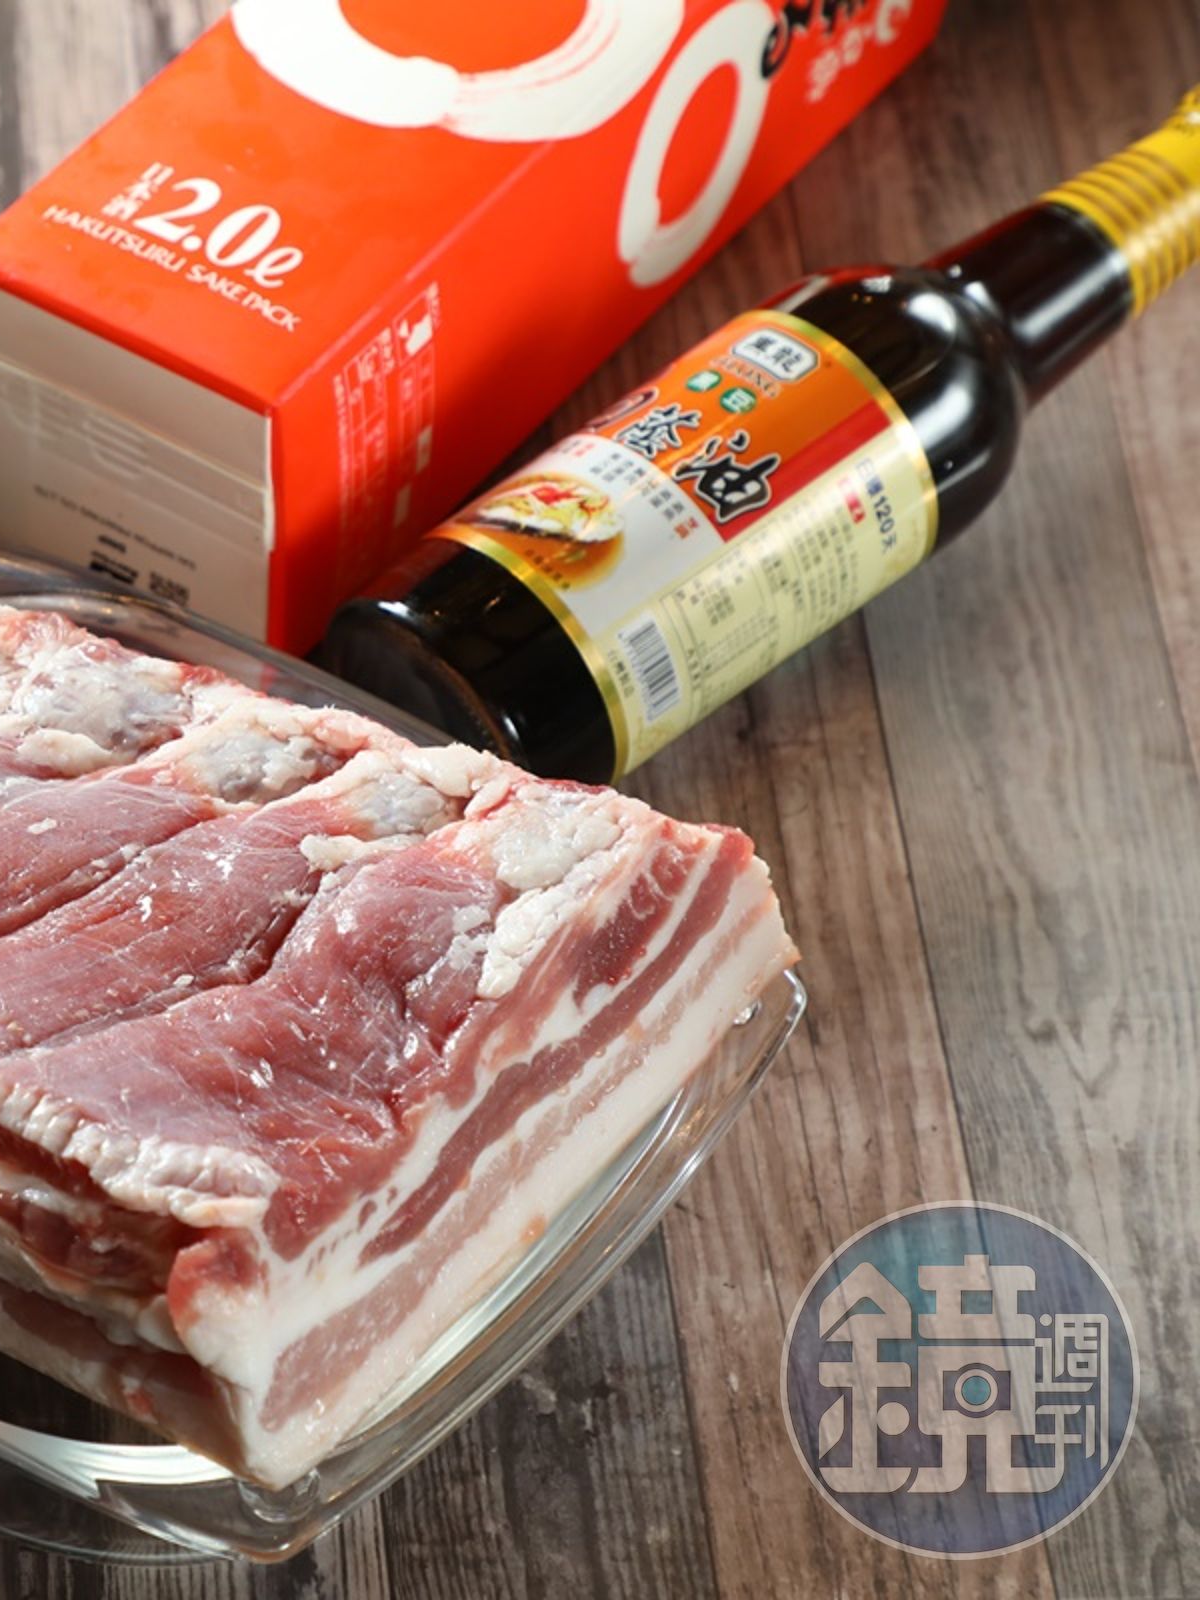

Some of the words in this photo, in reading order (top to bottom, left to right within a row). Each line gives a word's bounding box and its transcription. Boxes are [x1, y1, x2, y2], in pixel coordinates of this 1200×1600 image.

[41, 204, 188, 273] HAKUTSURU
[185, 263, 249, 302] SAKE
[241, 291, 302, 333] PACK
